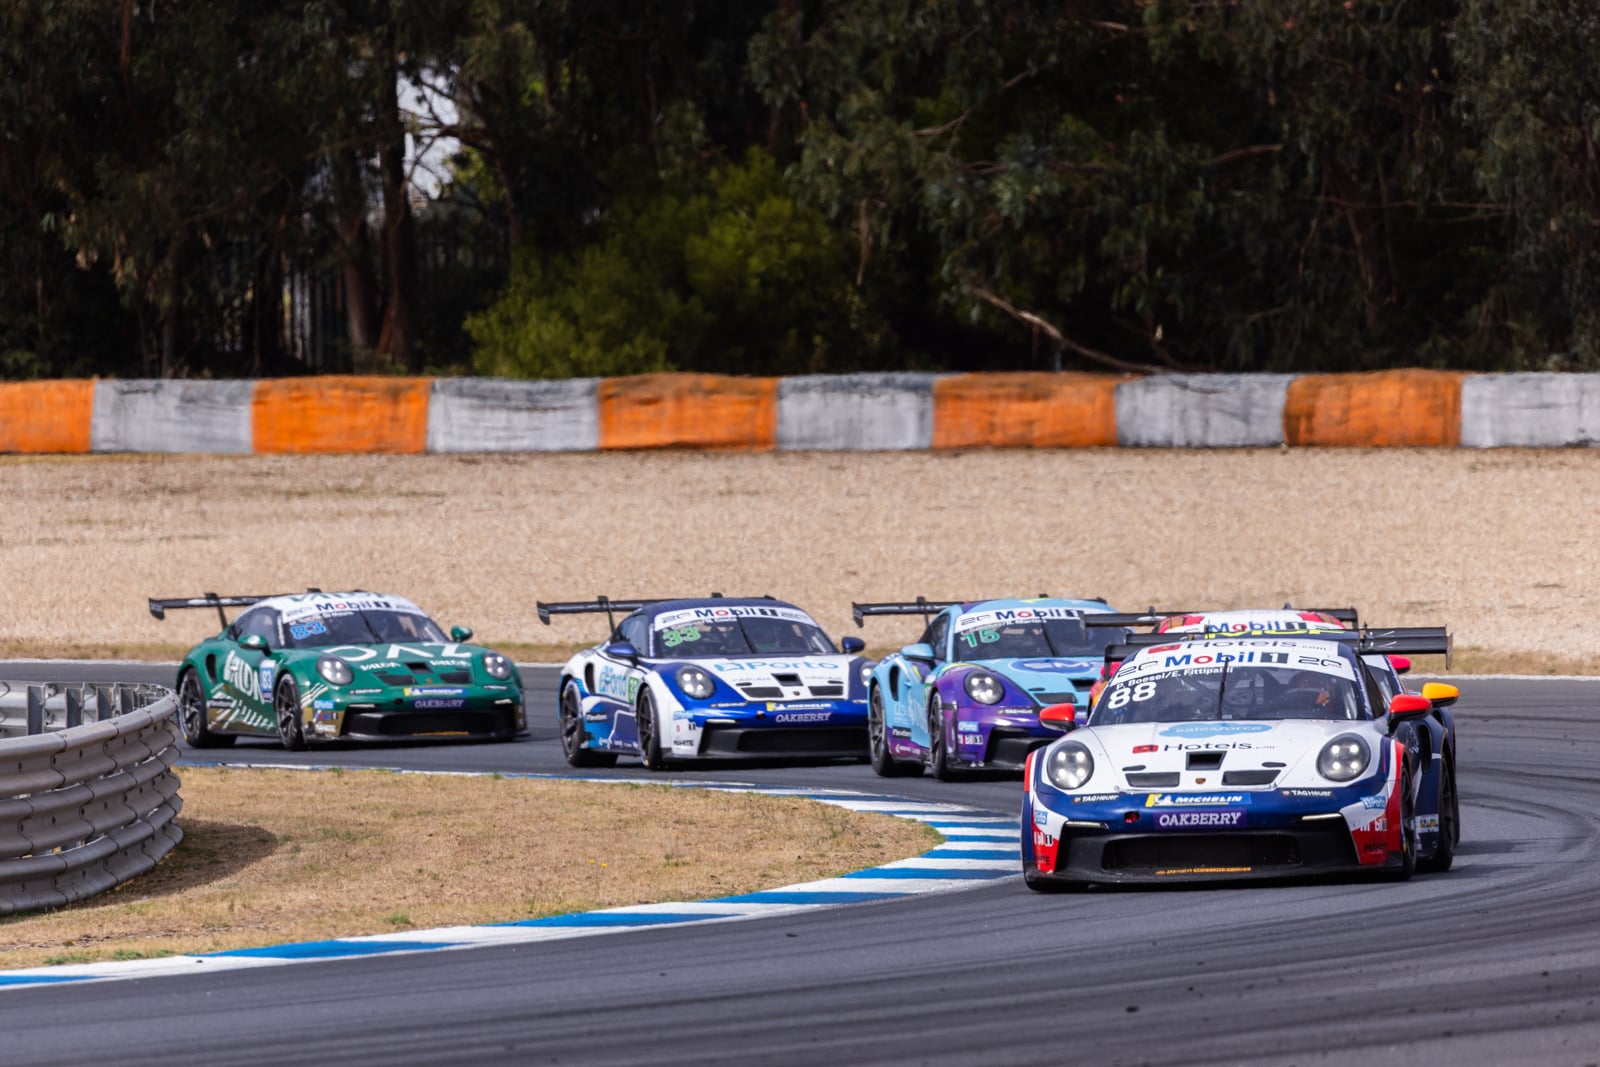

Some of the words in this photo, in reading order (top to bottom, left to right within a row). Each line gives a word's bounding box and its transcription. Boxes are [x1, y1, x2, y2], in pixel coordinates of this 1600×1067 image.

[316, 600, 372, 611] Mobil
[694, 608, 756, 618] Mobil
[994, 609, 1061, 620] Mobil
[290, 621, 327, 640] 83
[1208, 620, 1281, 632] Mobil
[662, 626, 701, 647] 33
[960, 627, 999, 648] 15
[1165, 651, 1254, 667] Mobil
[1260, 651, 1289, 665] 1
[1107, 682, 1157, 710] 88
[775, 712, 832, 723] OAKBERRY
[1175, 795, 1243, 804] MICHELIN
[1158, 811, 1242, 827] OAKBERRY
